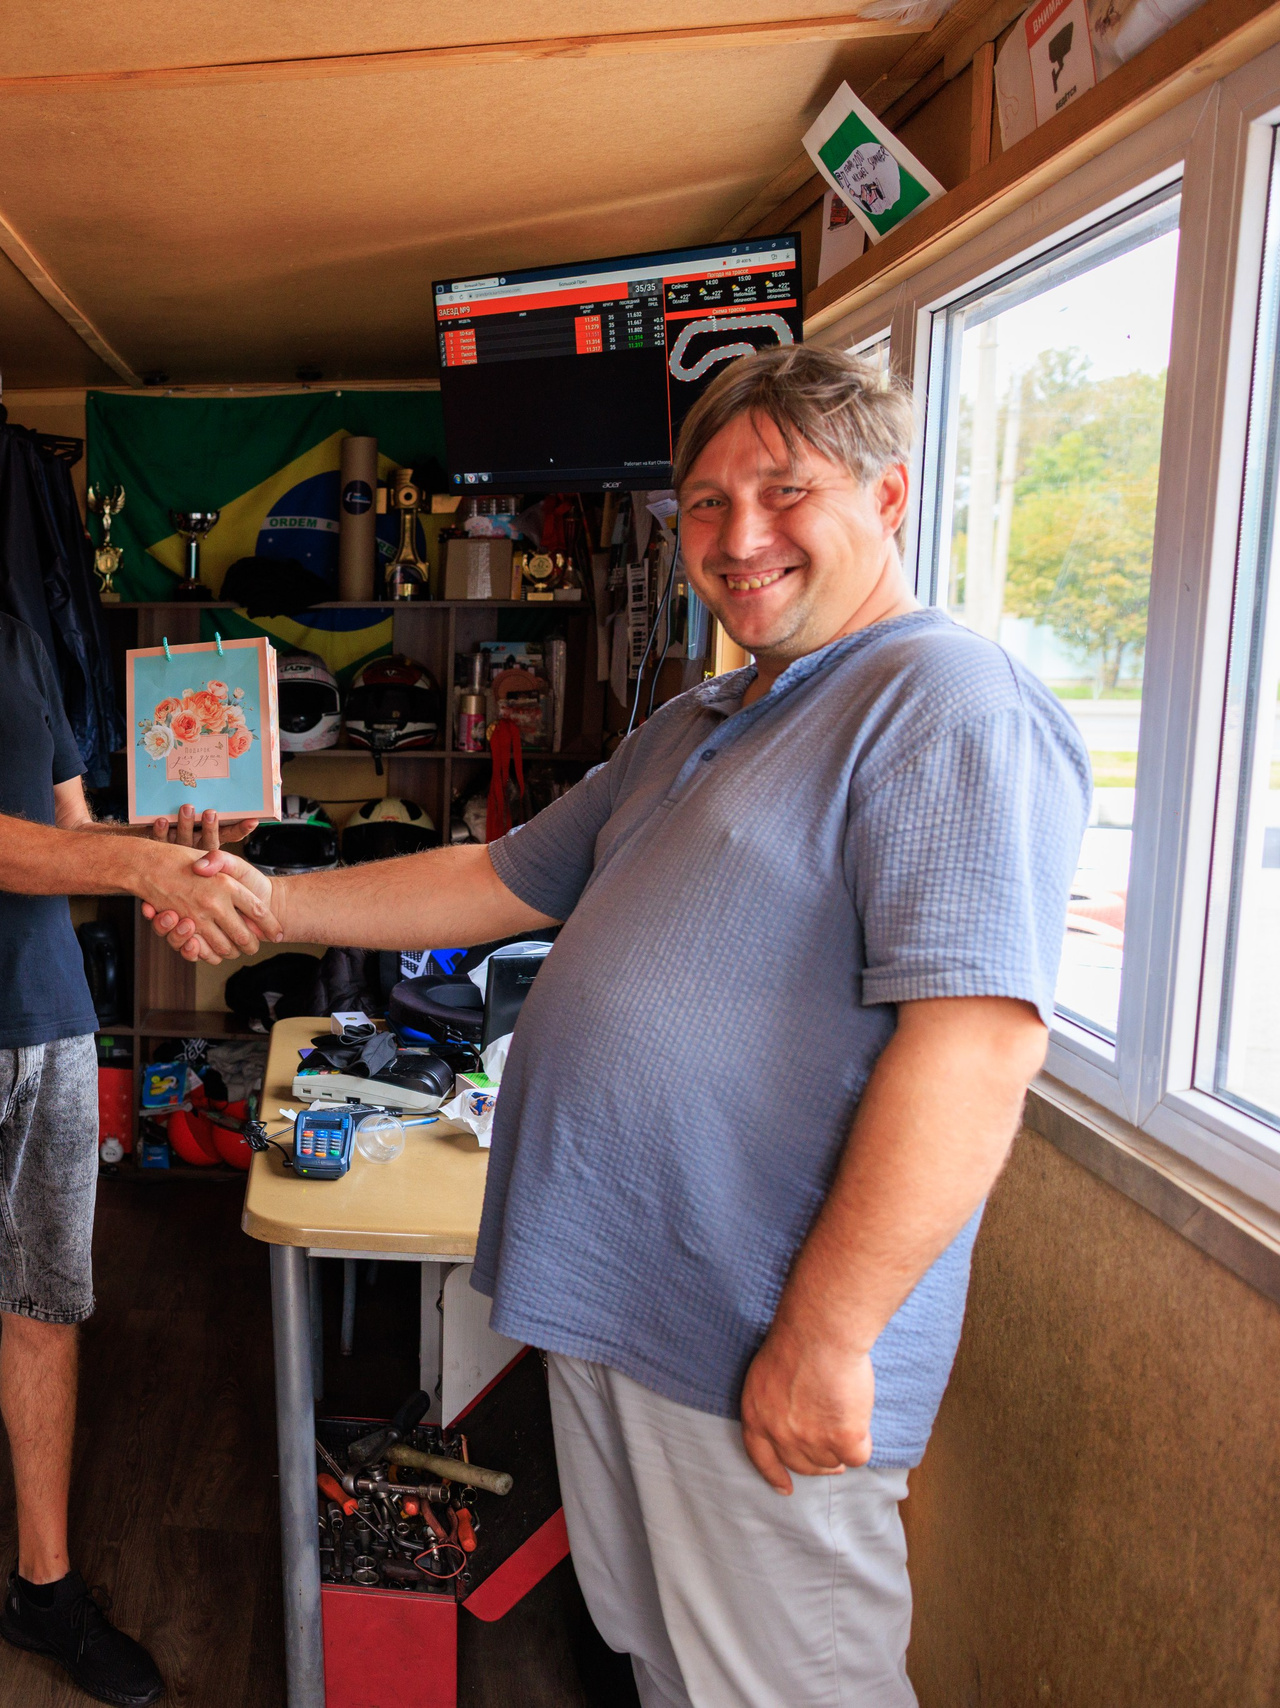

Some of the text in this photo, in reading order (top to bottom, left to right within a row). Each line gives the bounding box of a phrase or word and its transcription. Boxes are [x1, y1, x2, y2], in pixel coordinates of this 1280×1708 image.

[1033, 0, 1062, 35] ВНИМА
[635, 283, 656, 293] 35/35
[438, 306, 471, 317] ЗАЕЗД №9
[602, 481, 622, 489] acer
[269, 518, 318, 528] ORDEM
